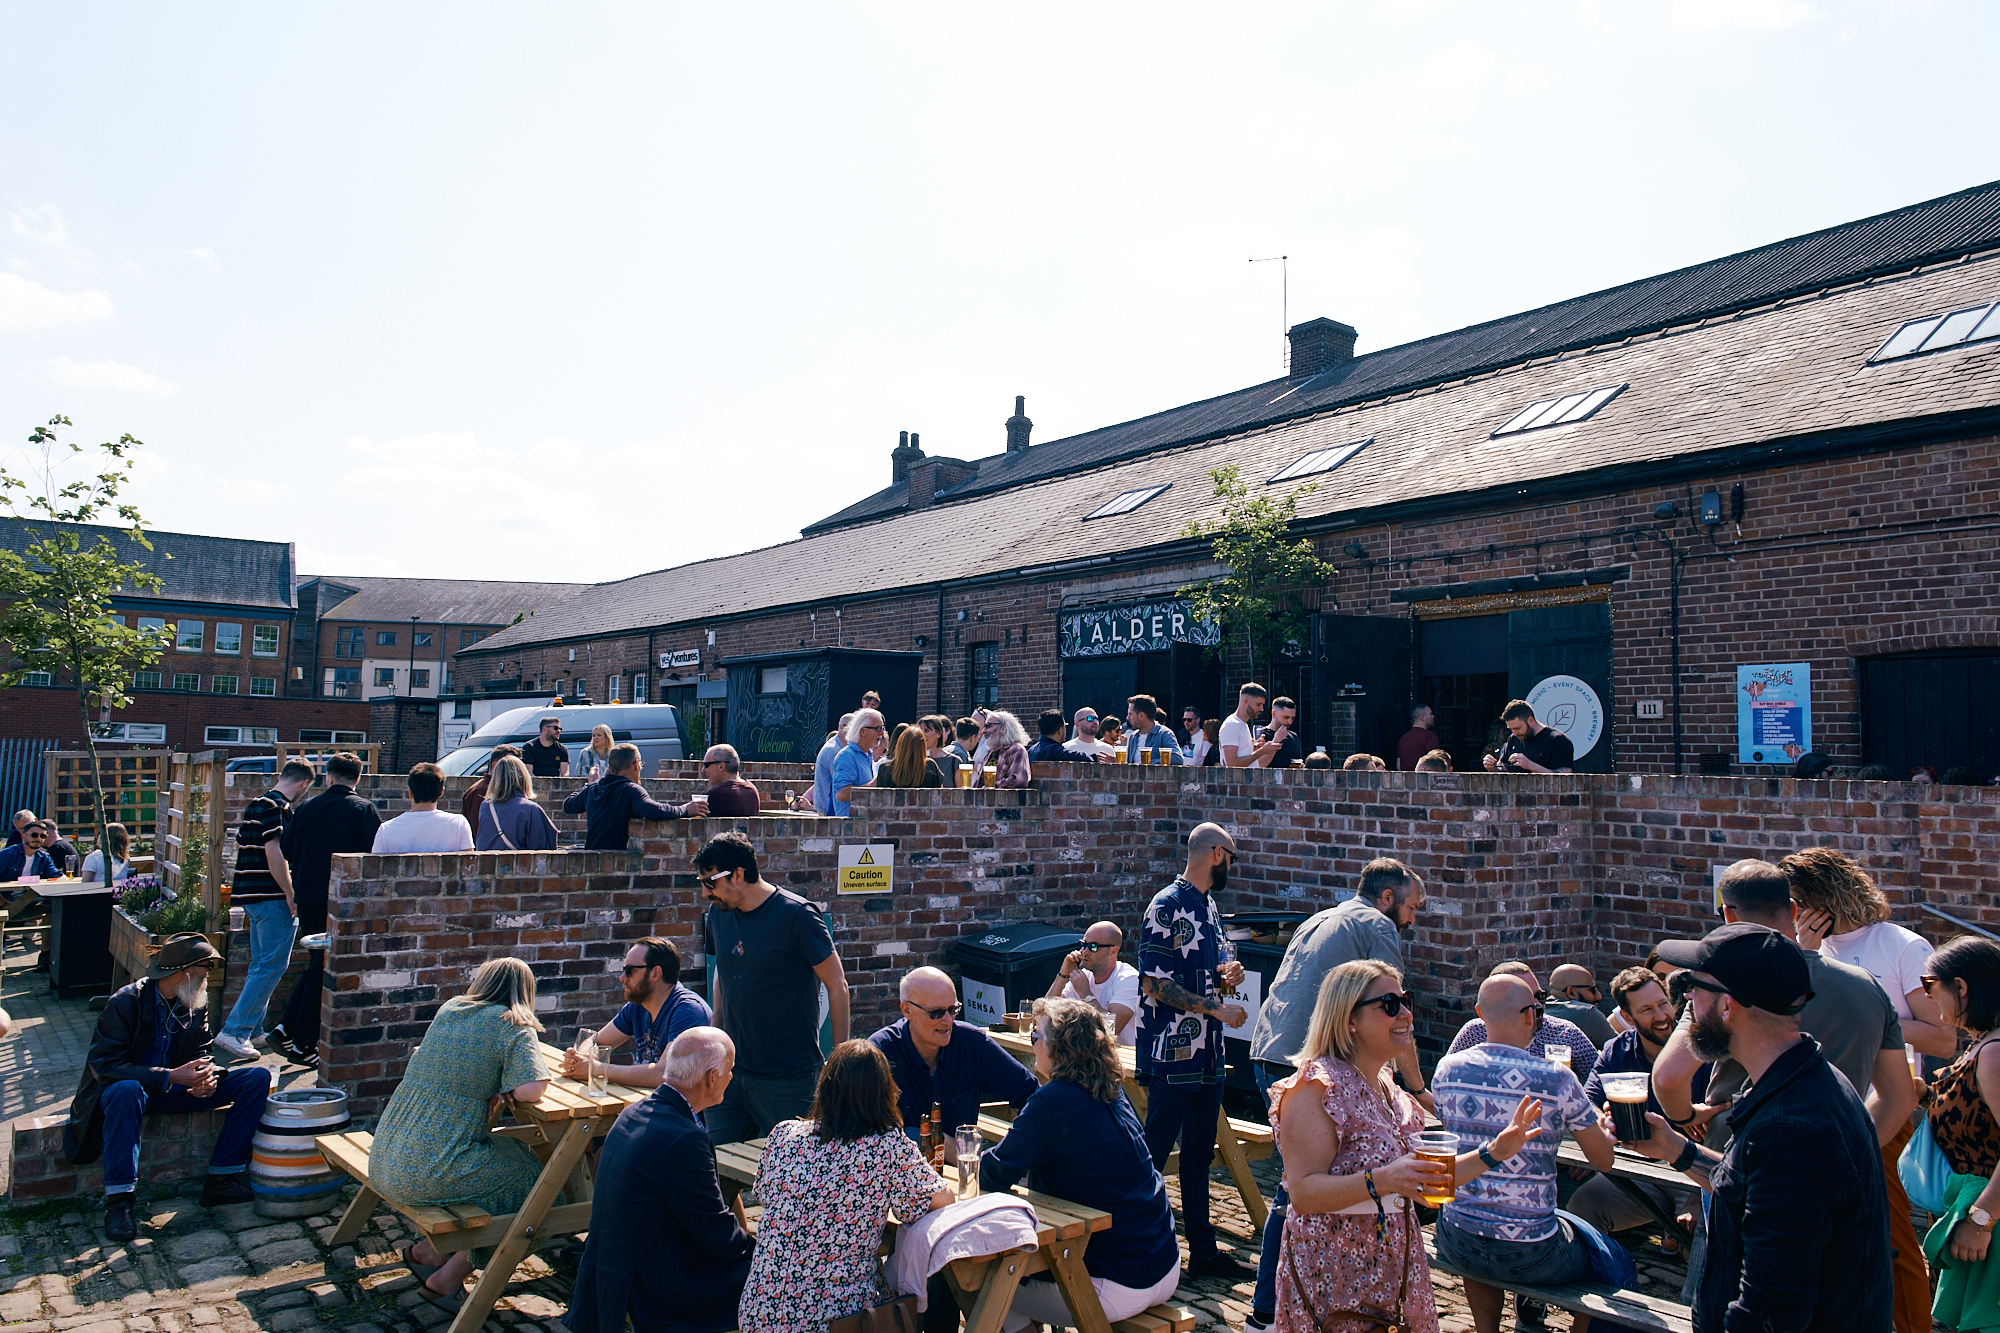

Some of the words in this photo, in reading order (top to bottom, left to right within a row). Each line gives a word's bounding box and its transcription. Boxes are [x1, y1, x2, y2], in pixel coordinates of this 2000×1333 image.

[1091, 613, 1185, 643] ALDER
[1531, 687, 1547, 705] MUSIC
[1575, 686, 1593, 704] SPACE
[1588, 710, 1598, 742] BREWERY
[1642, 704, 1658, 715] 111
[750, 727, 794, 758] Welcome
[849, 870, 883, 880] Caution
[967, 999, 996, 1015] SENSA
